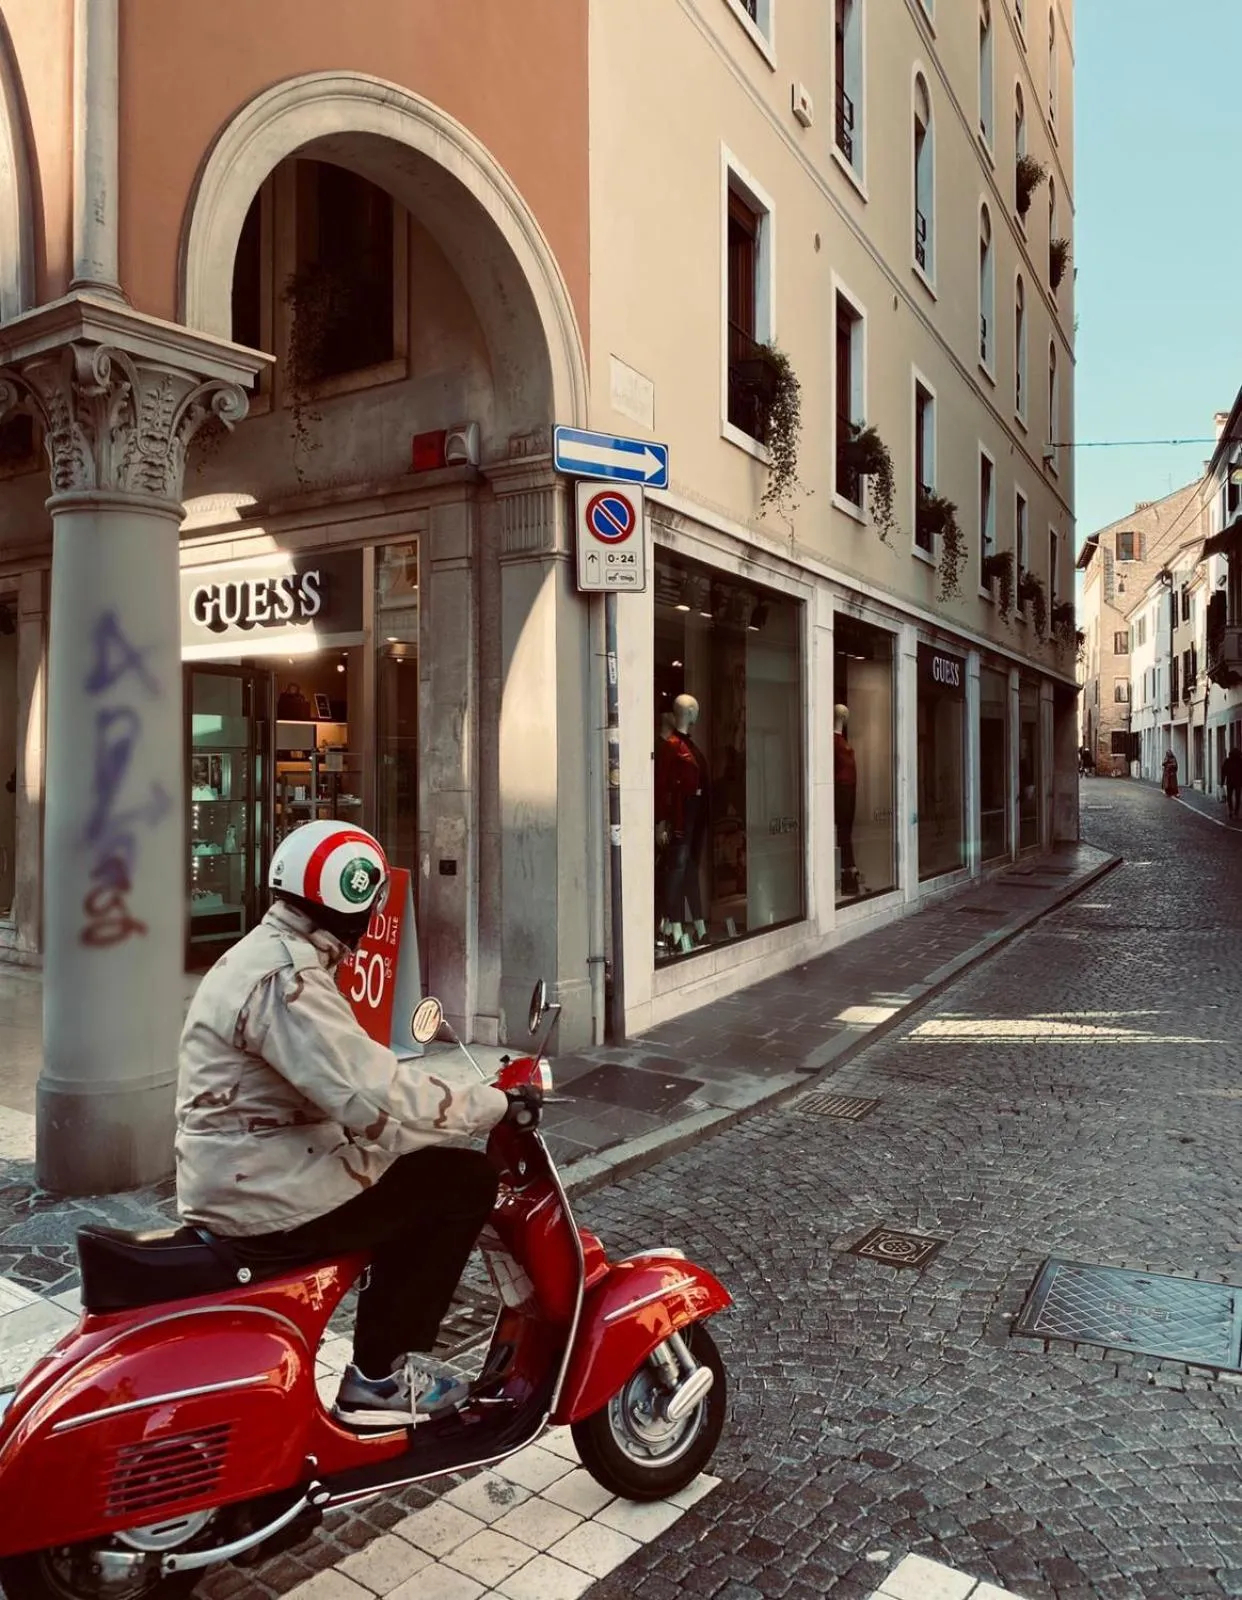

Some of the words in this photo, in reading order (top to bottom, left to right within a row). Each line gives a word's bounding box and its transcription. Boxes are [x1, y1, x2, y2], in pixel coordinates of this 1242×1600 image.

[608, 553, 634, 563] 0-24
[189, 570, 321, 627] GUESS
[933, 656, 960, 687] GUESS
[367, 913, 391, 943] LDI
